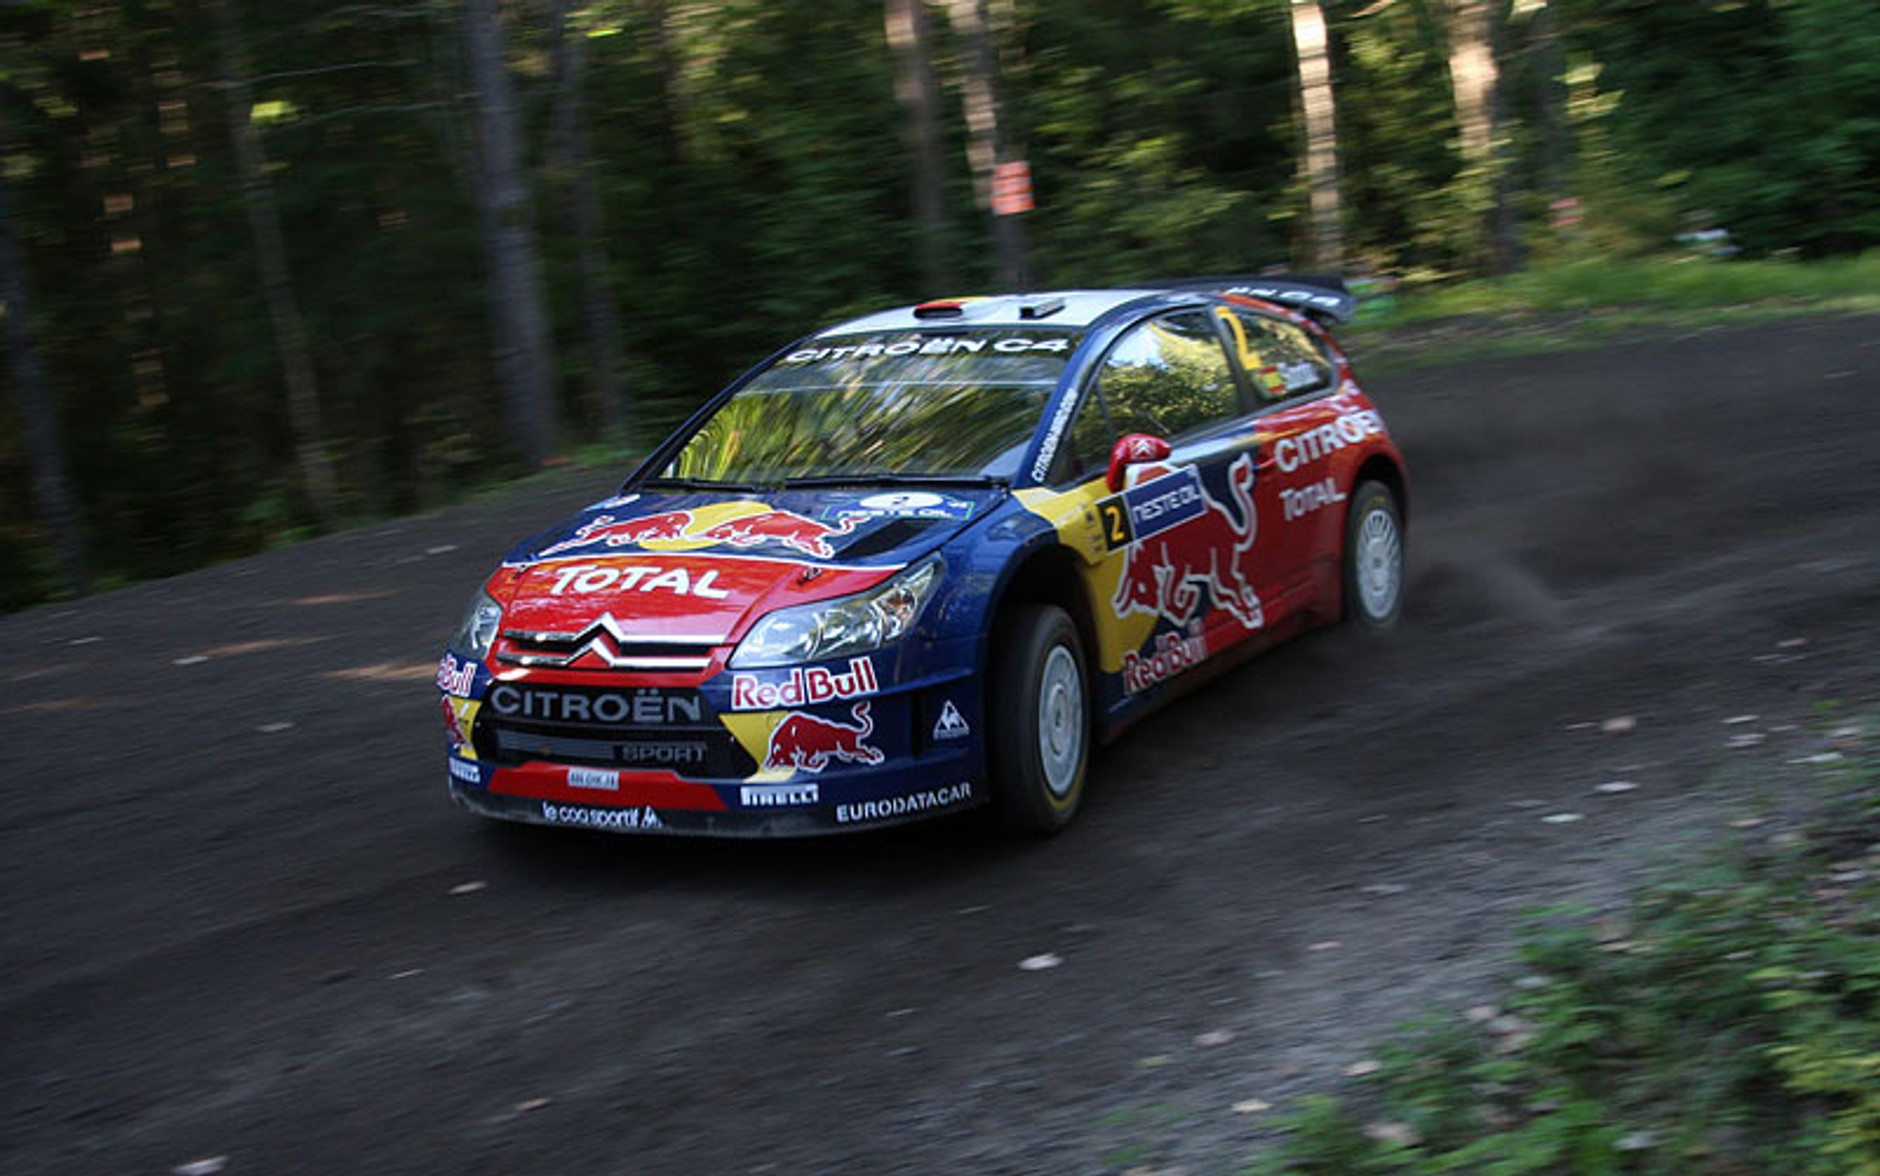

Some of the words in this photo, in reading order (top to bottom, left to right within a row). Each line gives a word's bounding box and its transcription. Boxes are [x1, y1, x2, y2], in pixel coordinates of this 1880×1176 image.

[993, 338, 1070, 352] C4
[1214, 305, 1262, 370] 2
[1279, 476, 1348, 522] TOTAL
[1105, 505, 1125, 542] 2
[551, 564, 730, 600] TOTAL
[733, 669, 804, 709] Red
[806, 657, 878, 702] Bull
[1123, 633, 1167, 696] Red
[490, 682, 702, 724] CITROËN
[621, 744, 709, 763] SPORT
[740, 784, 819, 806] PIRELLI
[836, 782, 972, 822] EURODATACAR
